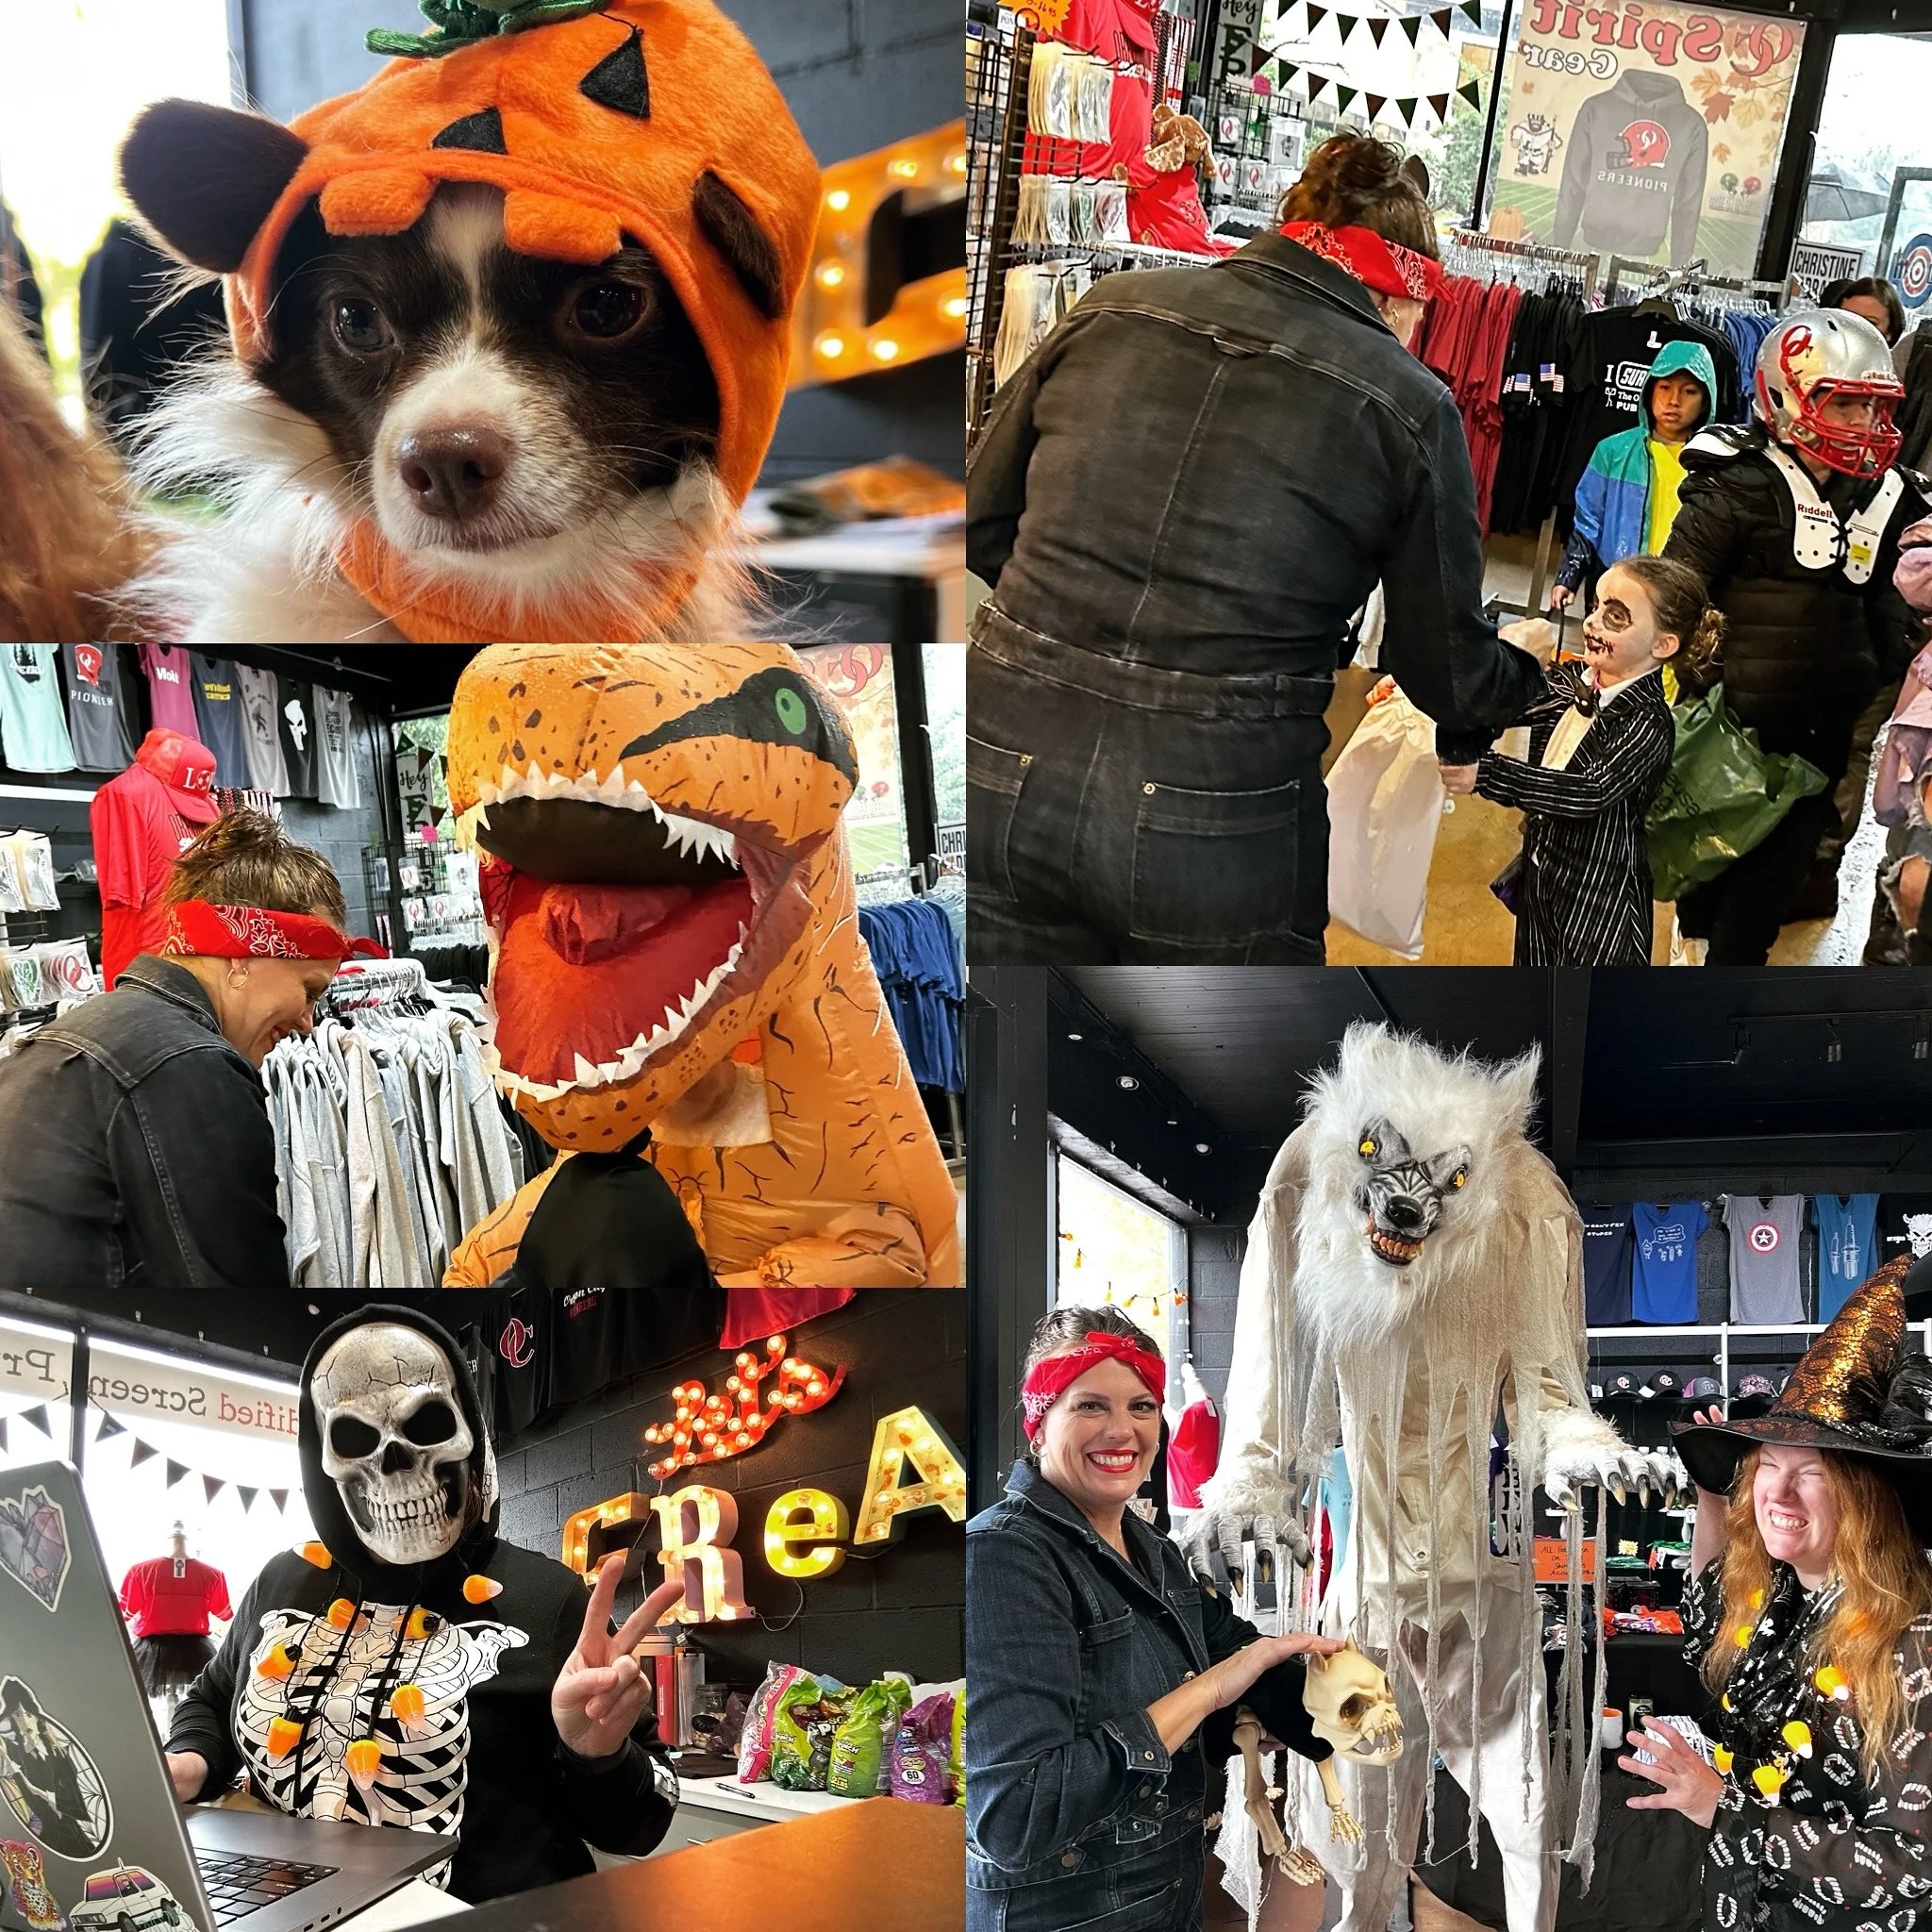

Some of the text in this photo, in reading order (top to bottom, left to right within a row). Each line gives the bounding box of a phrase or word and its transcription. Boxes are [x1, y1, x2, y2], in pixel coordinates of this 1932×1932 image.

[1794, 250, 1857, 281] CHRISTINE
[1617, 391, 1640, 402] The O
[1797, 504, 1833, 519] Riddell
[400, 770, 428, 791] Hey
[907, 1771, 919, 1780] 60
